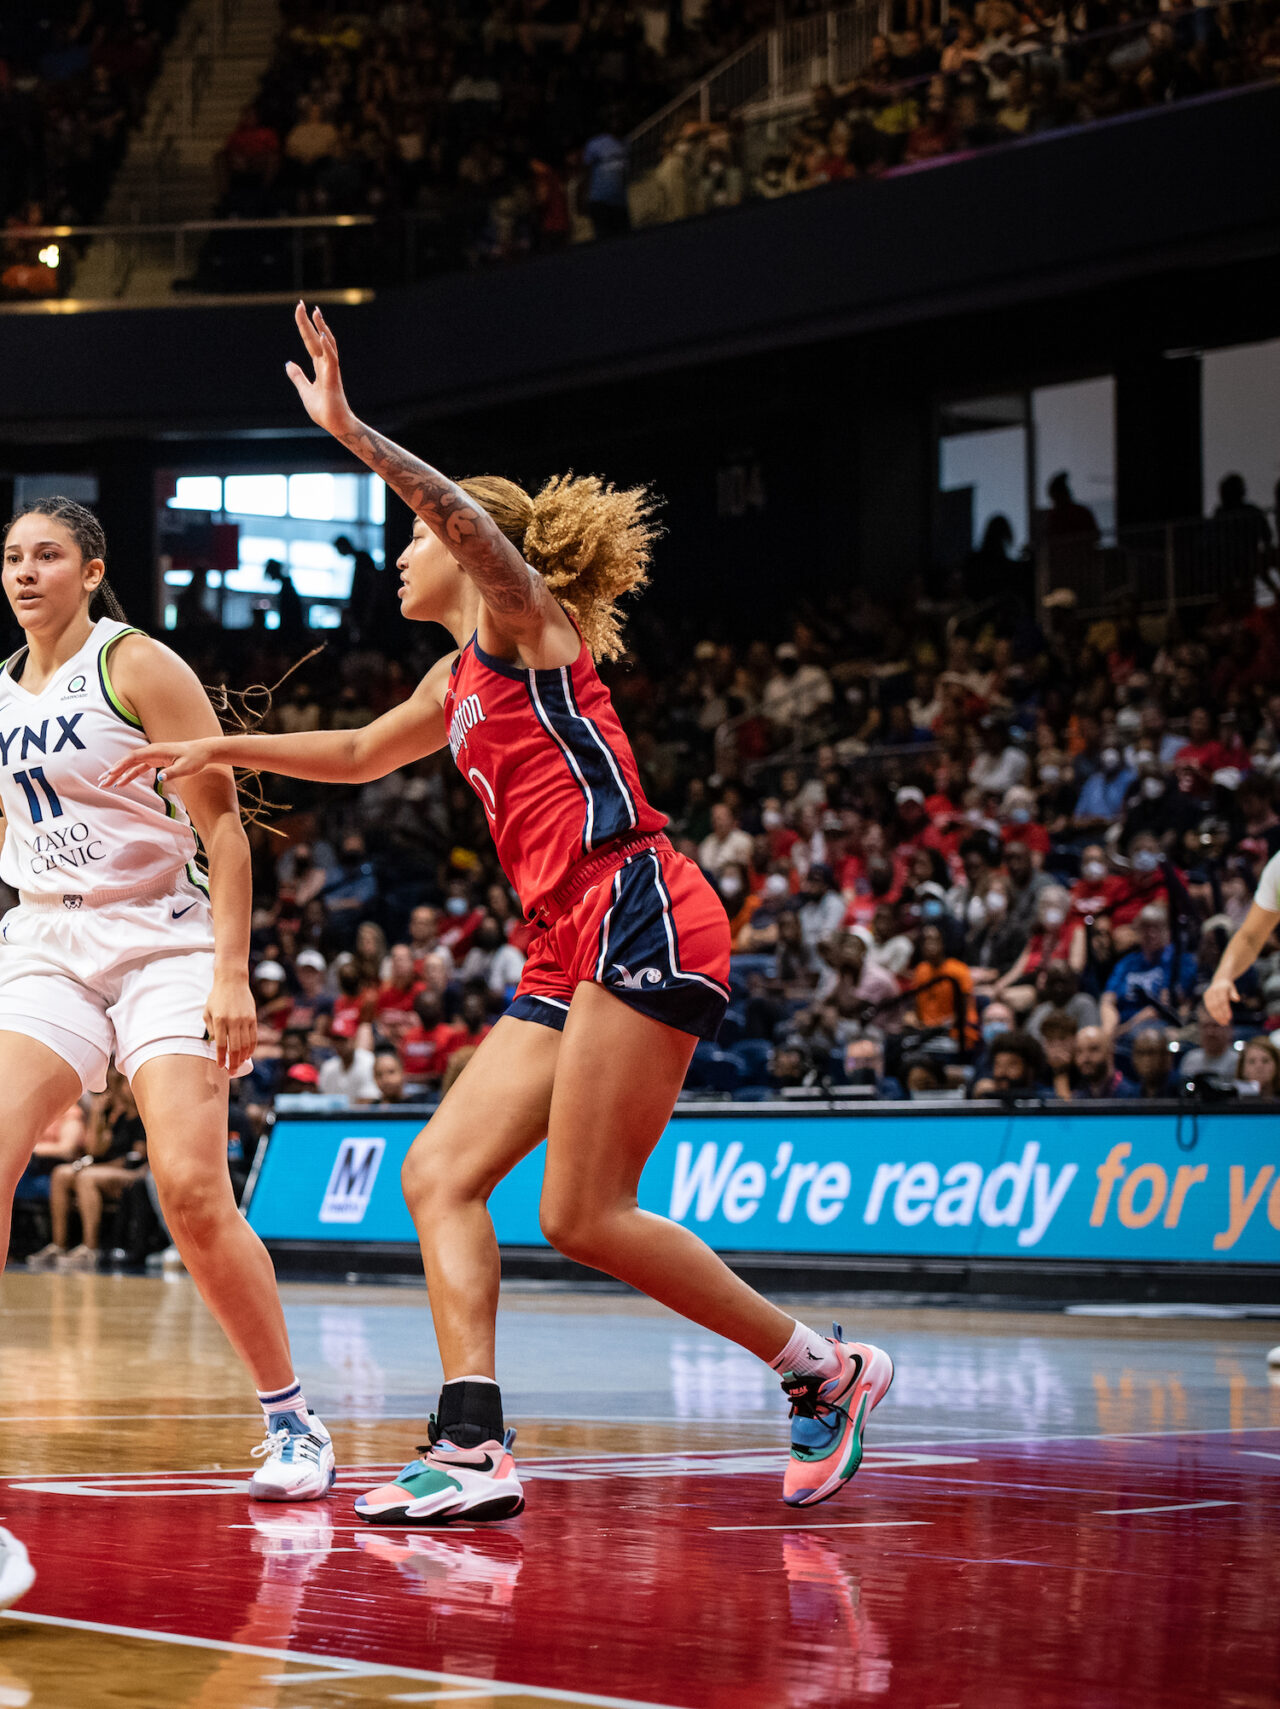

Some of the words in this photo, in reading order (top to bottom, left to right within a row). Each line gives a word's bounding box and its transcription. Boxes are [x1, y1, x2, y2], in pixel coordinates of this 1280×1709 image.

[13, 766, 64, 824] 11
[669, 1141, 851, 1224] We're
[863, 1141, 1078, 1247] ready
[1090, 1143, 1208, 1229] for
[1212, 1165, 1280, 1250] y
